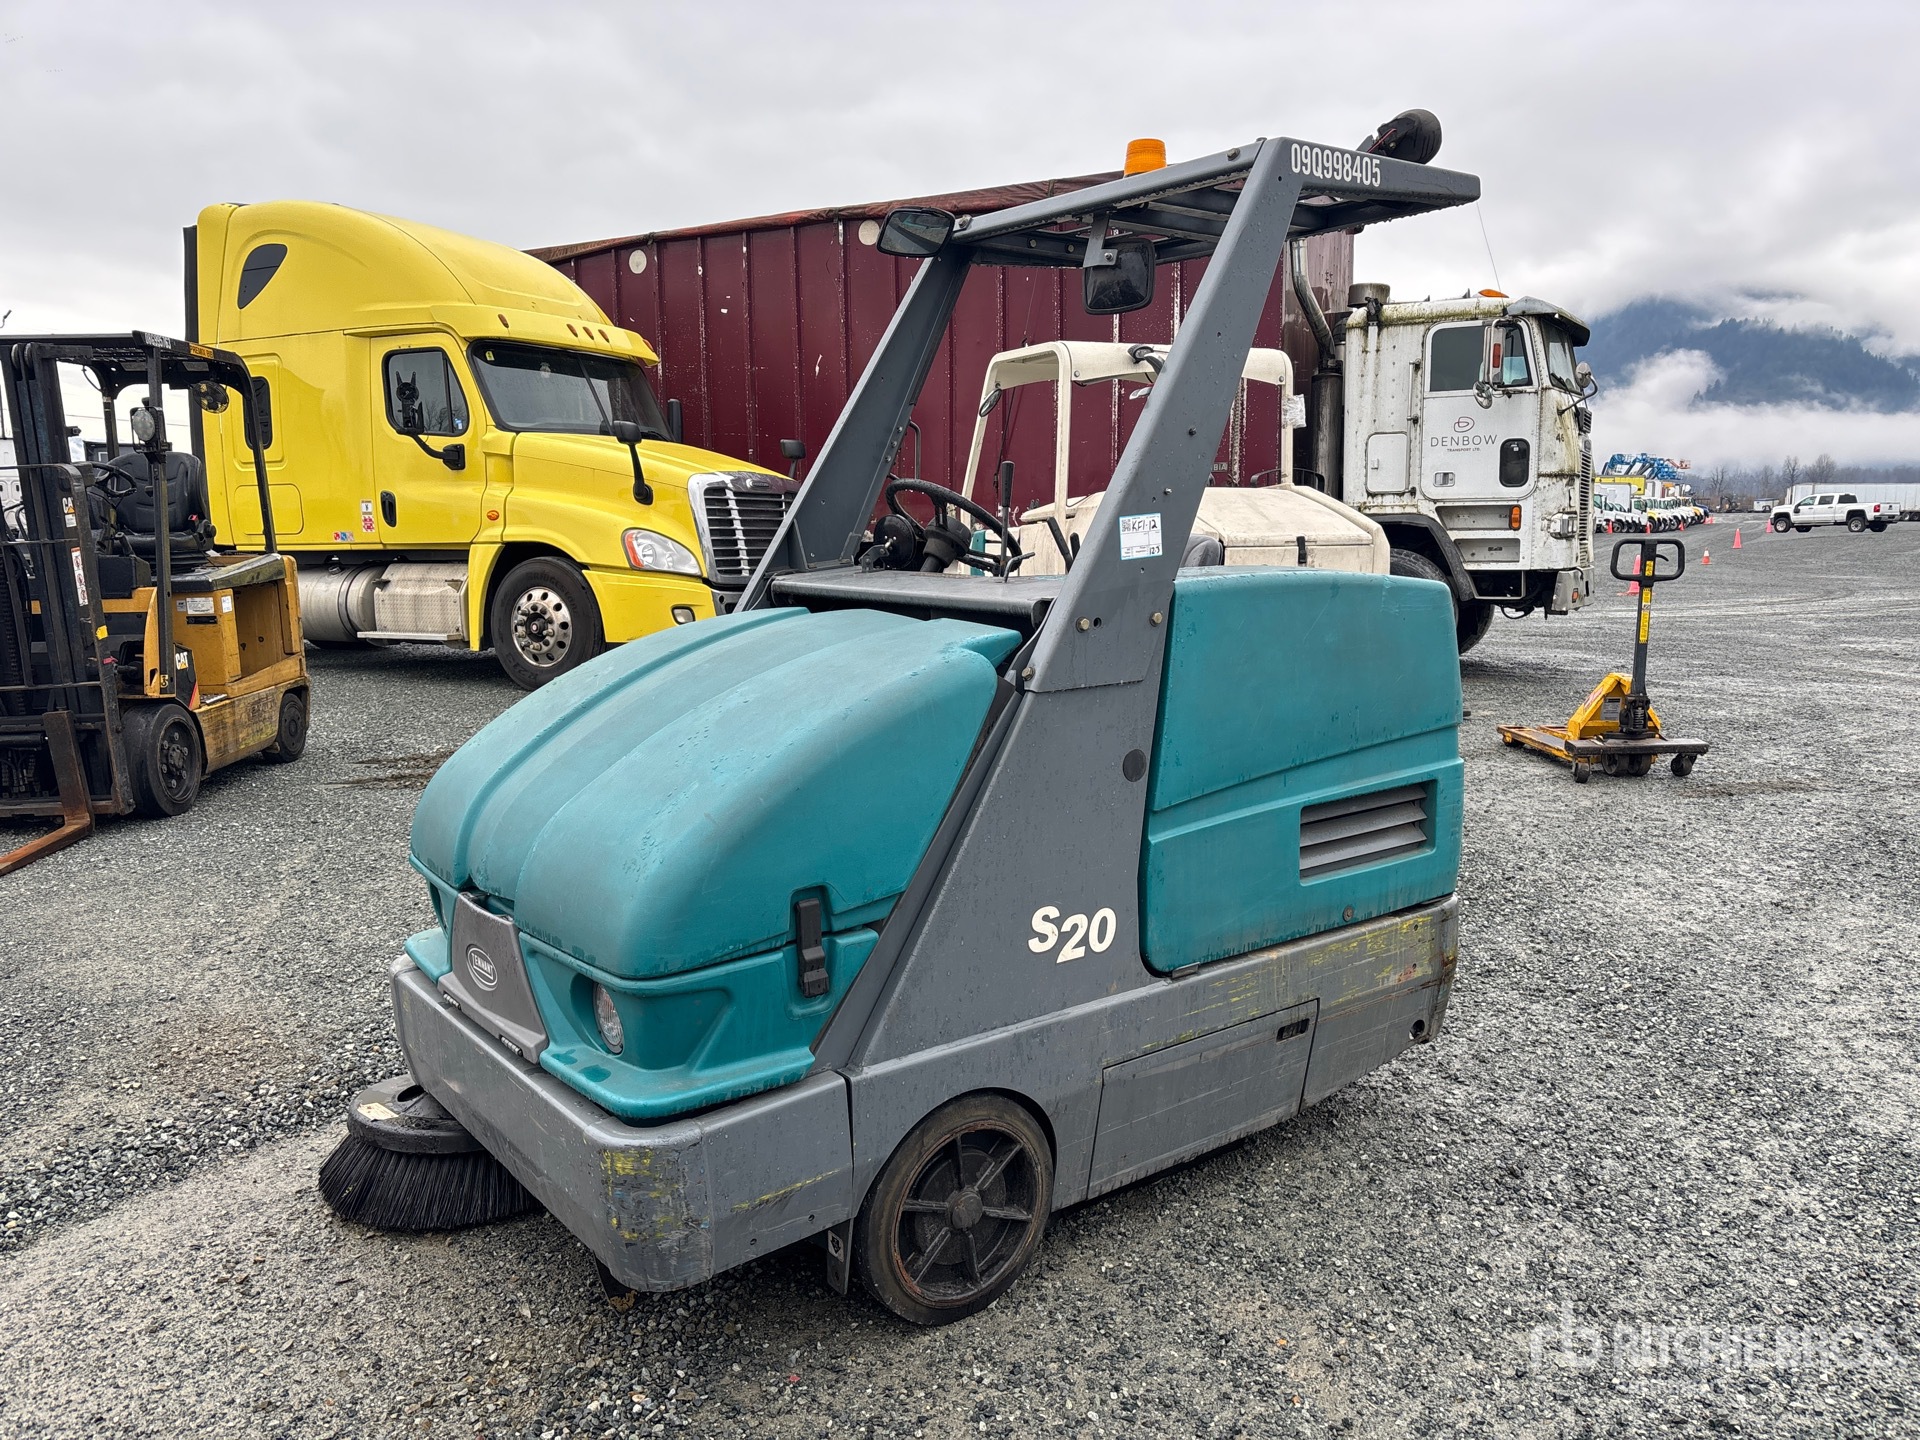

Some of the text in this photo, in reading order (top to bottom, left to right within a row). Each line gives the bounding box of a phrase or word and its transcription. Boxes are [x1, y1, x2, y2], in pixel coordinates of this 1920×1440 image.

[1291, 143, 1381, 187] 09Q998405
[1430, 434, 1498, 447] DENBOW
[175, 651, 189, 670] CAT
[1028, 905, 1117, 964] S20
[471, 952, 494, 980] TENNANT
